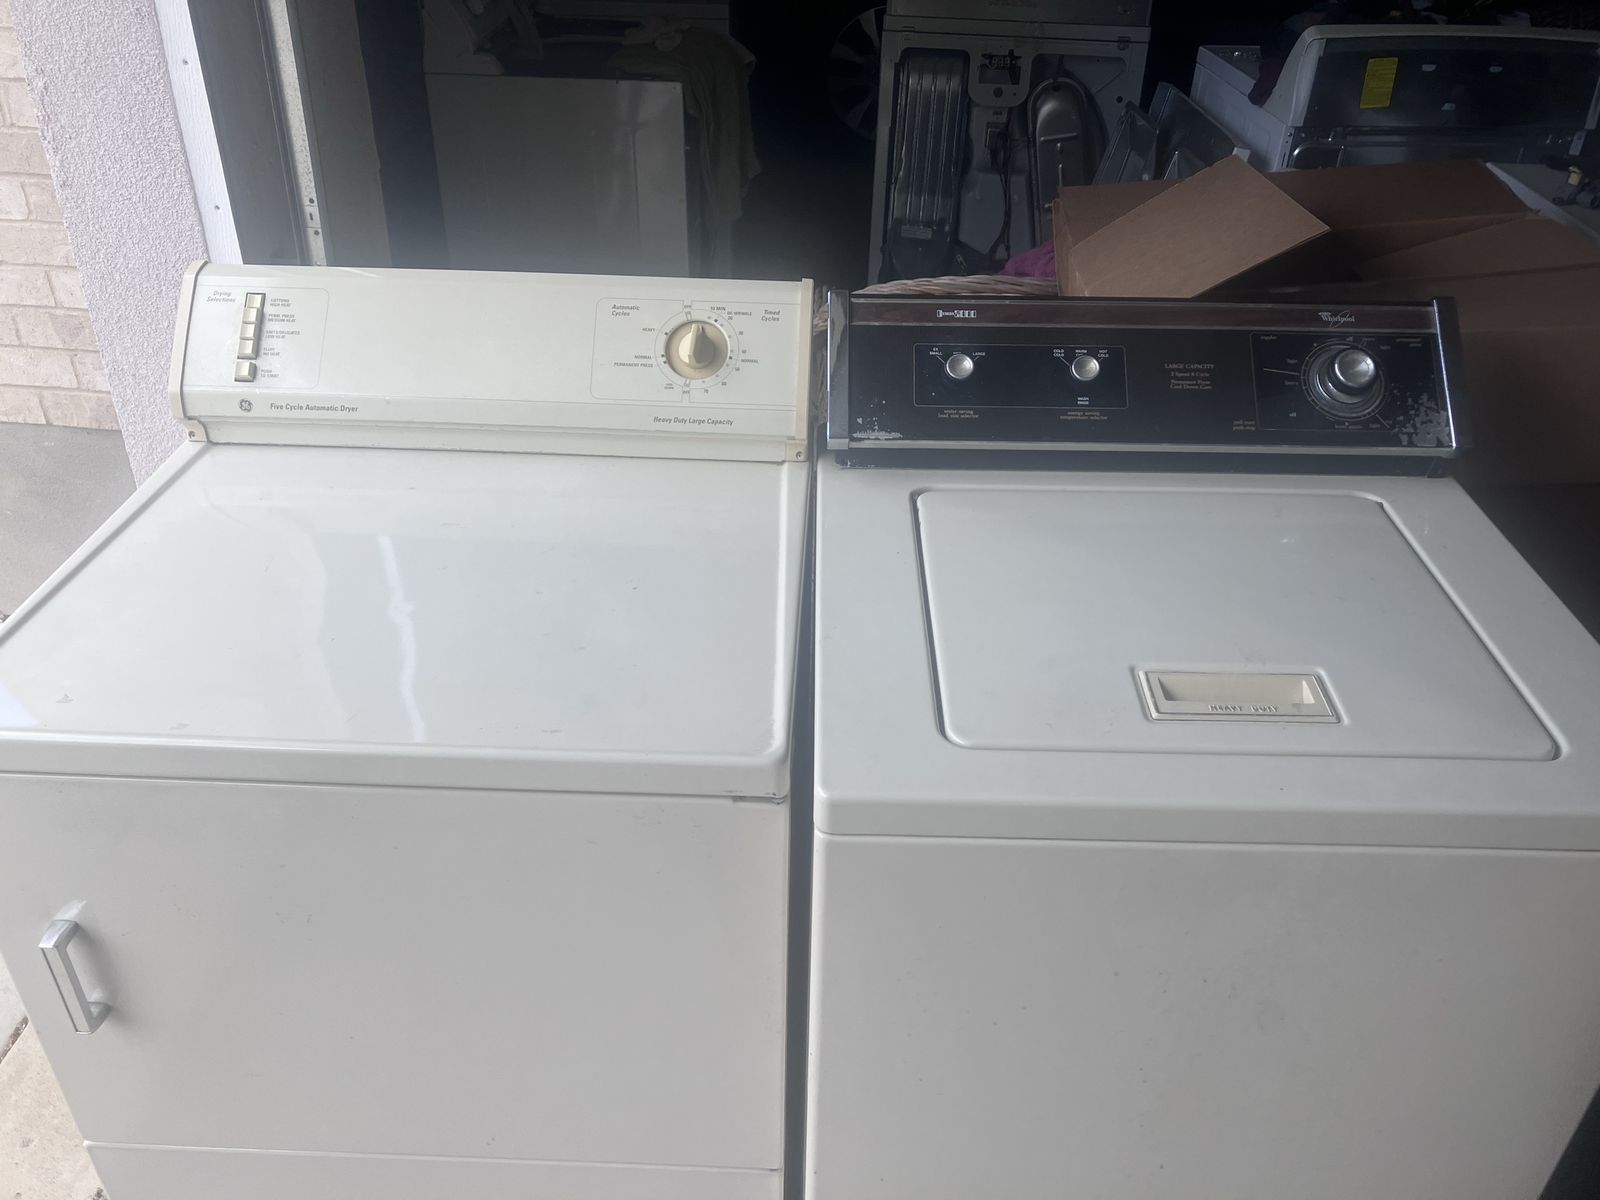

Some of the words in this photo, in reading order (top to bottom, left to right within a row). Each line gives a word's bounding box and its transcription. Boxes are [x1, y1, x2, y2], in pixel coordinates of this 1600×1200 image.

[1318, 311, 1355, 322] Whirlpool
[285, 403, 303, 411] Cycle
[305, 404, 338, 412] Automatic
[340, 405, 359, 413] Dryer
[653, 416, 672, 424] Heavy
[673, 416, 687, 424] Duty
[688, 417, 706, 425] Large
[706, 418, 734, 427] Capacity
[1208, 704, 1243, 712] HEAVY
[1249, 704, 1280, 713] DUTY
